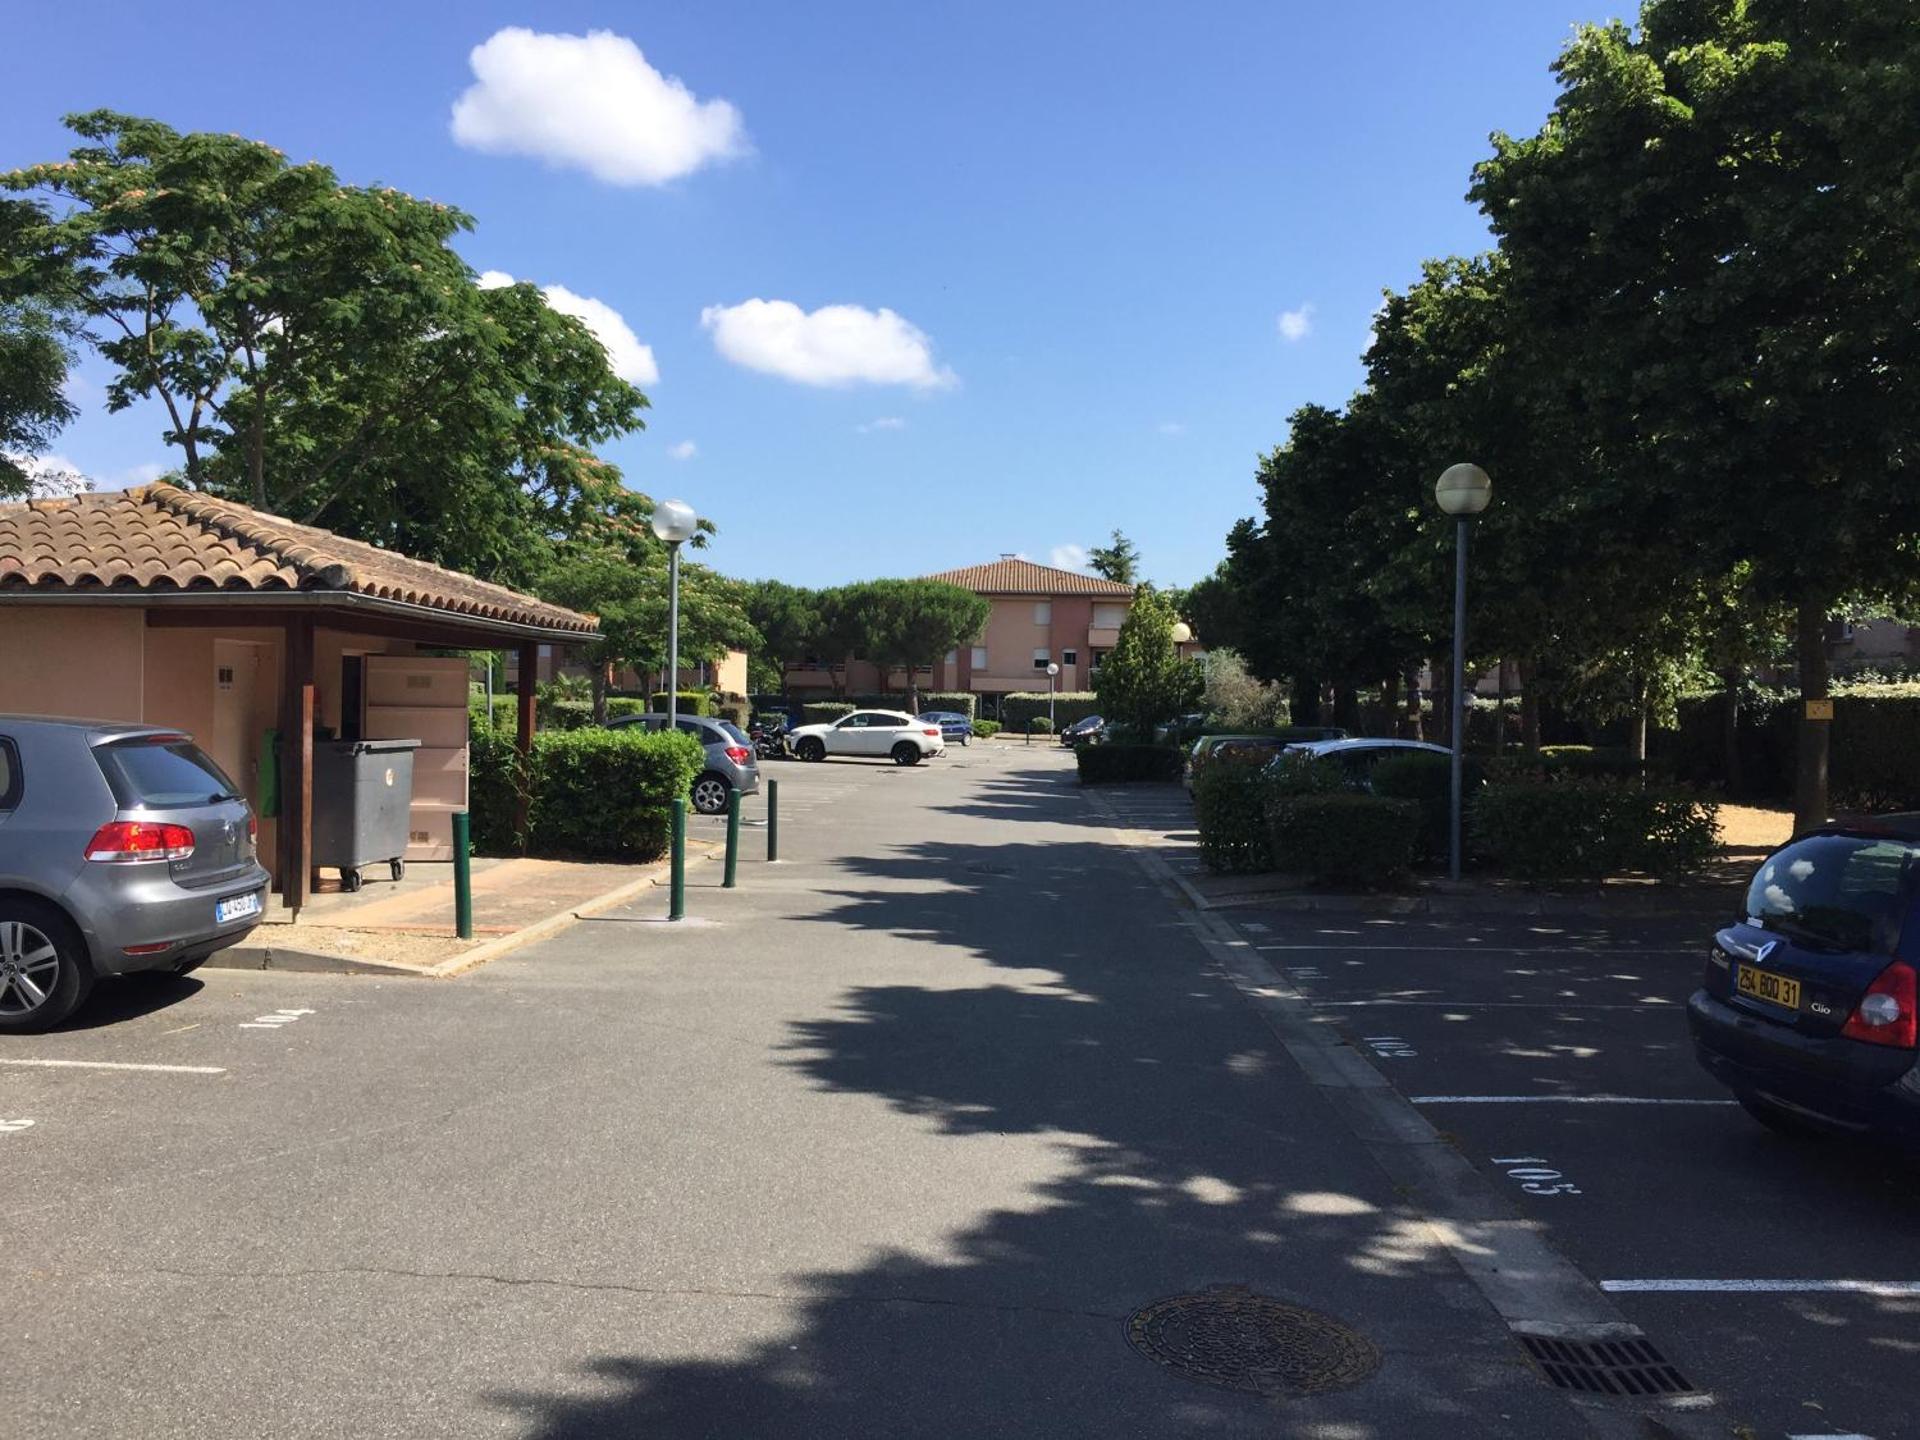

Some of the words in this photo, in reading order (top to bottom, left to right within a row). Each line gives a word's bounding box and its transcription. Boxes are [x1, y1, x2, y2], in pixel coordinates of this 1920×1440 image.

[1783, 981, 1797, 1006] 31
[1810, 1002, 1832, 1015] Clio
[1490, 1157, 1583, 1195] 105
